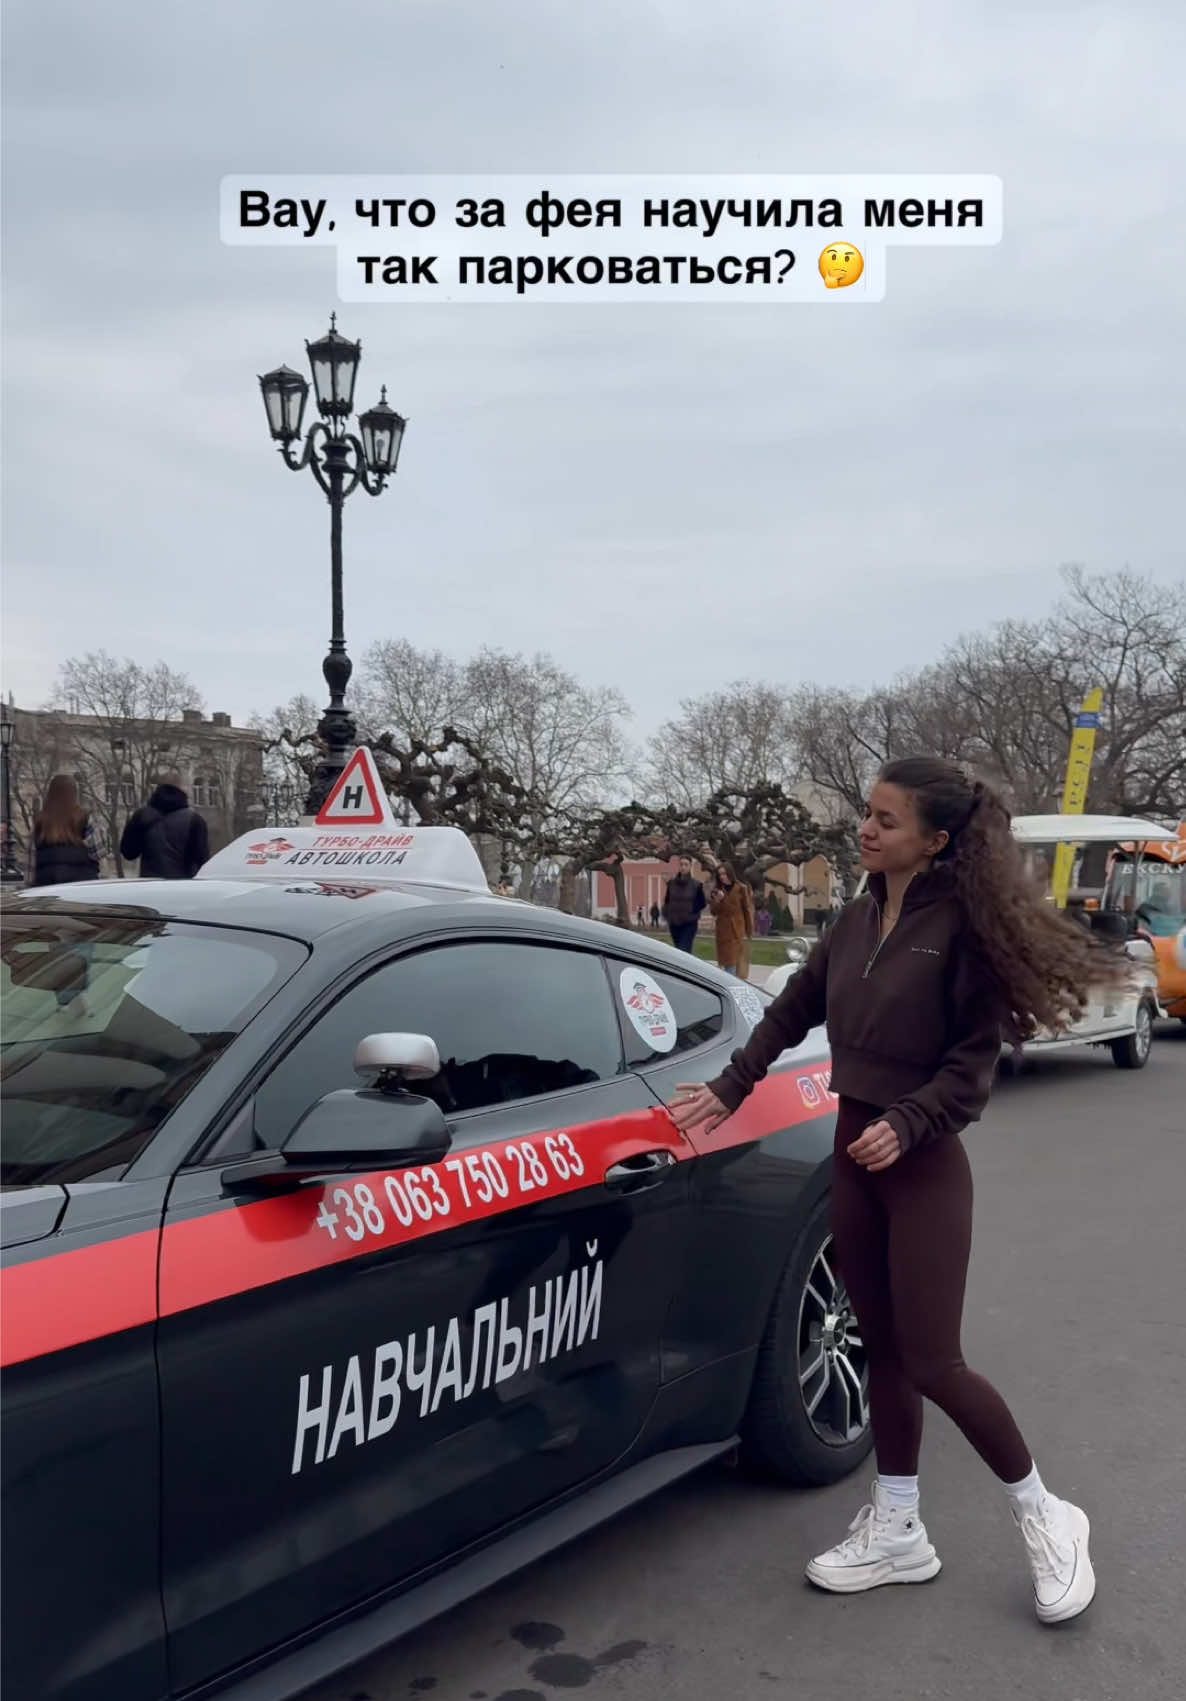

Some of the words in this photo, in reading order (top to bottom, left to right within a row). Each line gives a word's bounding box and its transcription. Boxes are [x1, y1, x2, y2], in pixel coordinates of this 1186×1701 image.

[284, 851, 408, 865] АВТОШКОЛА
[316, 1183, 385, 1241] +38
[384, 1166, 450, 1227] 063
[446, 1151, 509, 1207] 750
[506, 1141, 548, 1191] 28
[545, 1133, 585, 1181] 63
[291, 1238, 603, 1475] НАВЧАЛЬНИЙ
